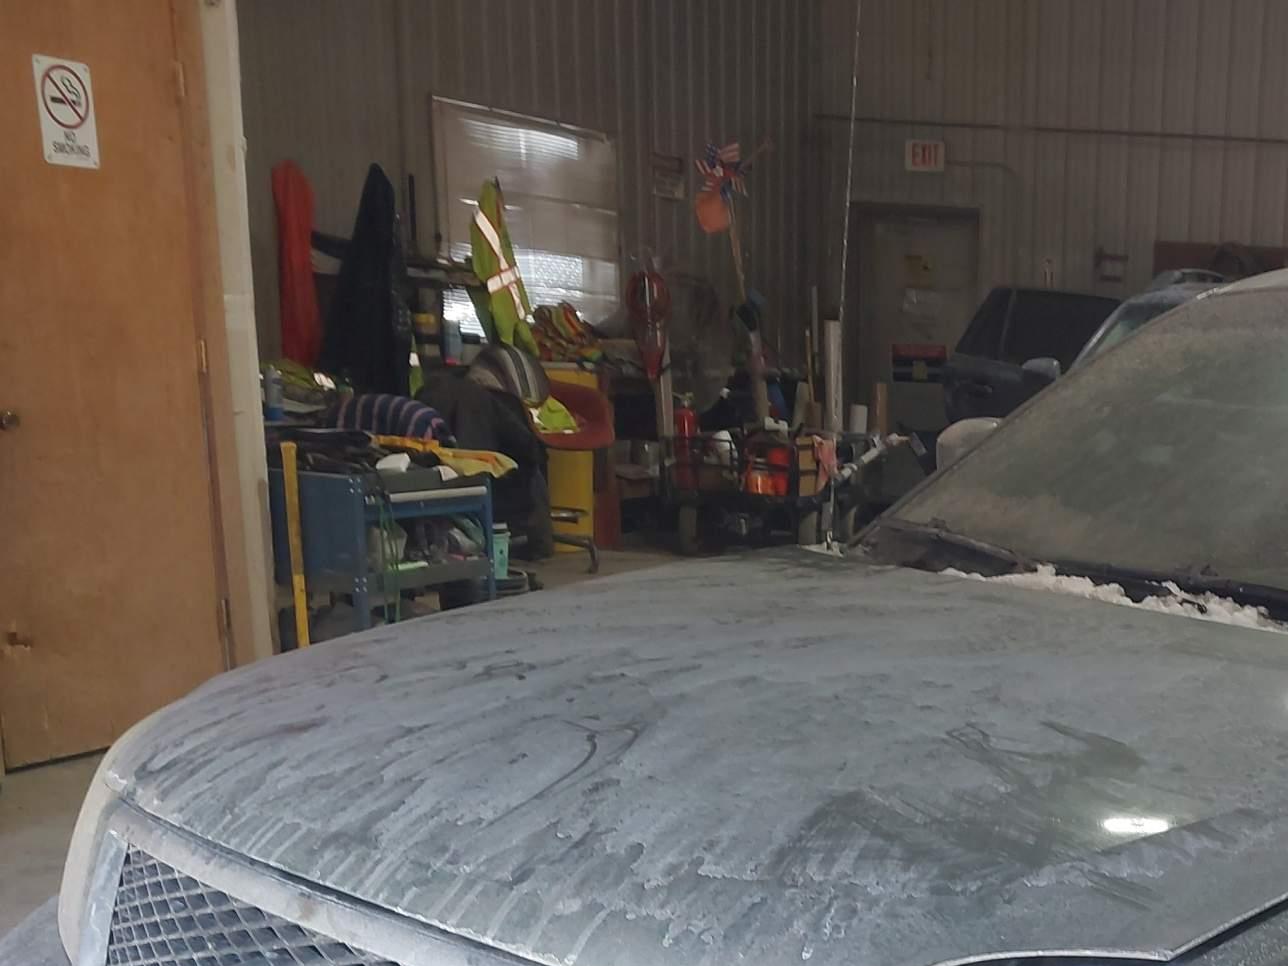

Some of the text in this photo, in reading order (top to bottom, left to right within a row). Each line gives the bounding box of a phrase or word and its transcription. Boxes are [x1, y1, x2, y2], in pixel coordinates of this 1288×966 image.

[63, 130, 76, 143] NO
[53, 142, 91, 157] SMOKING
[911, 143, 938, 166] EXIT
